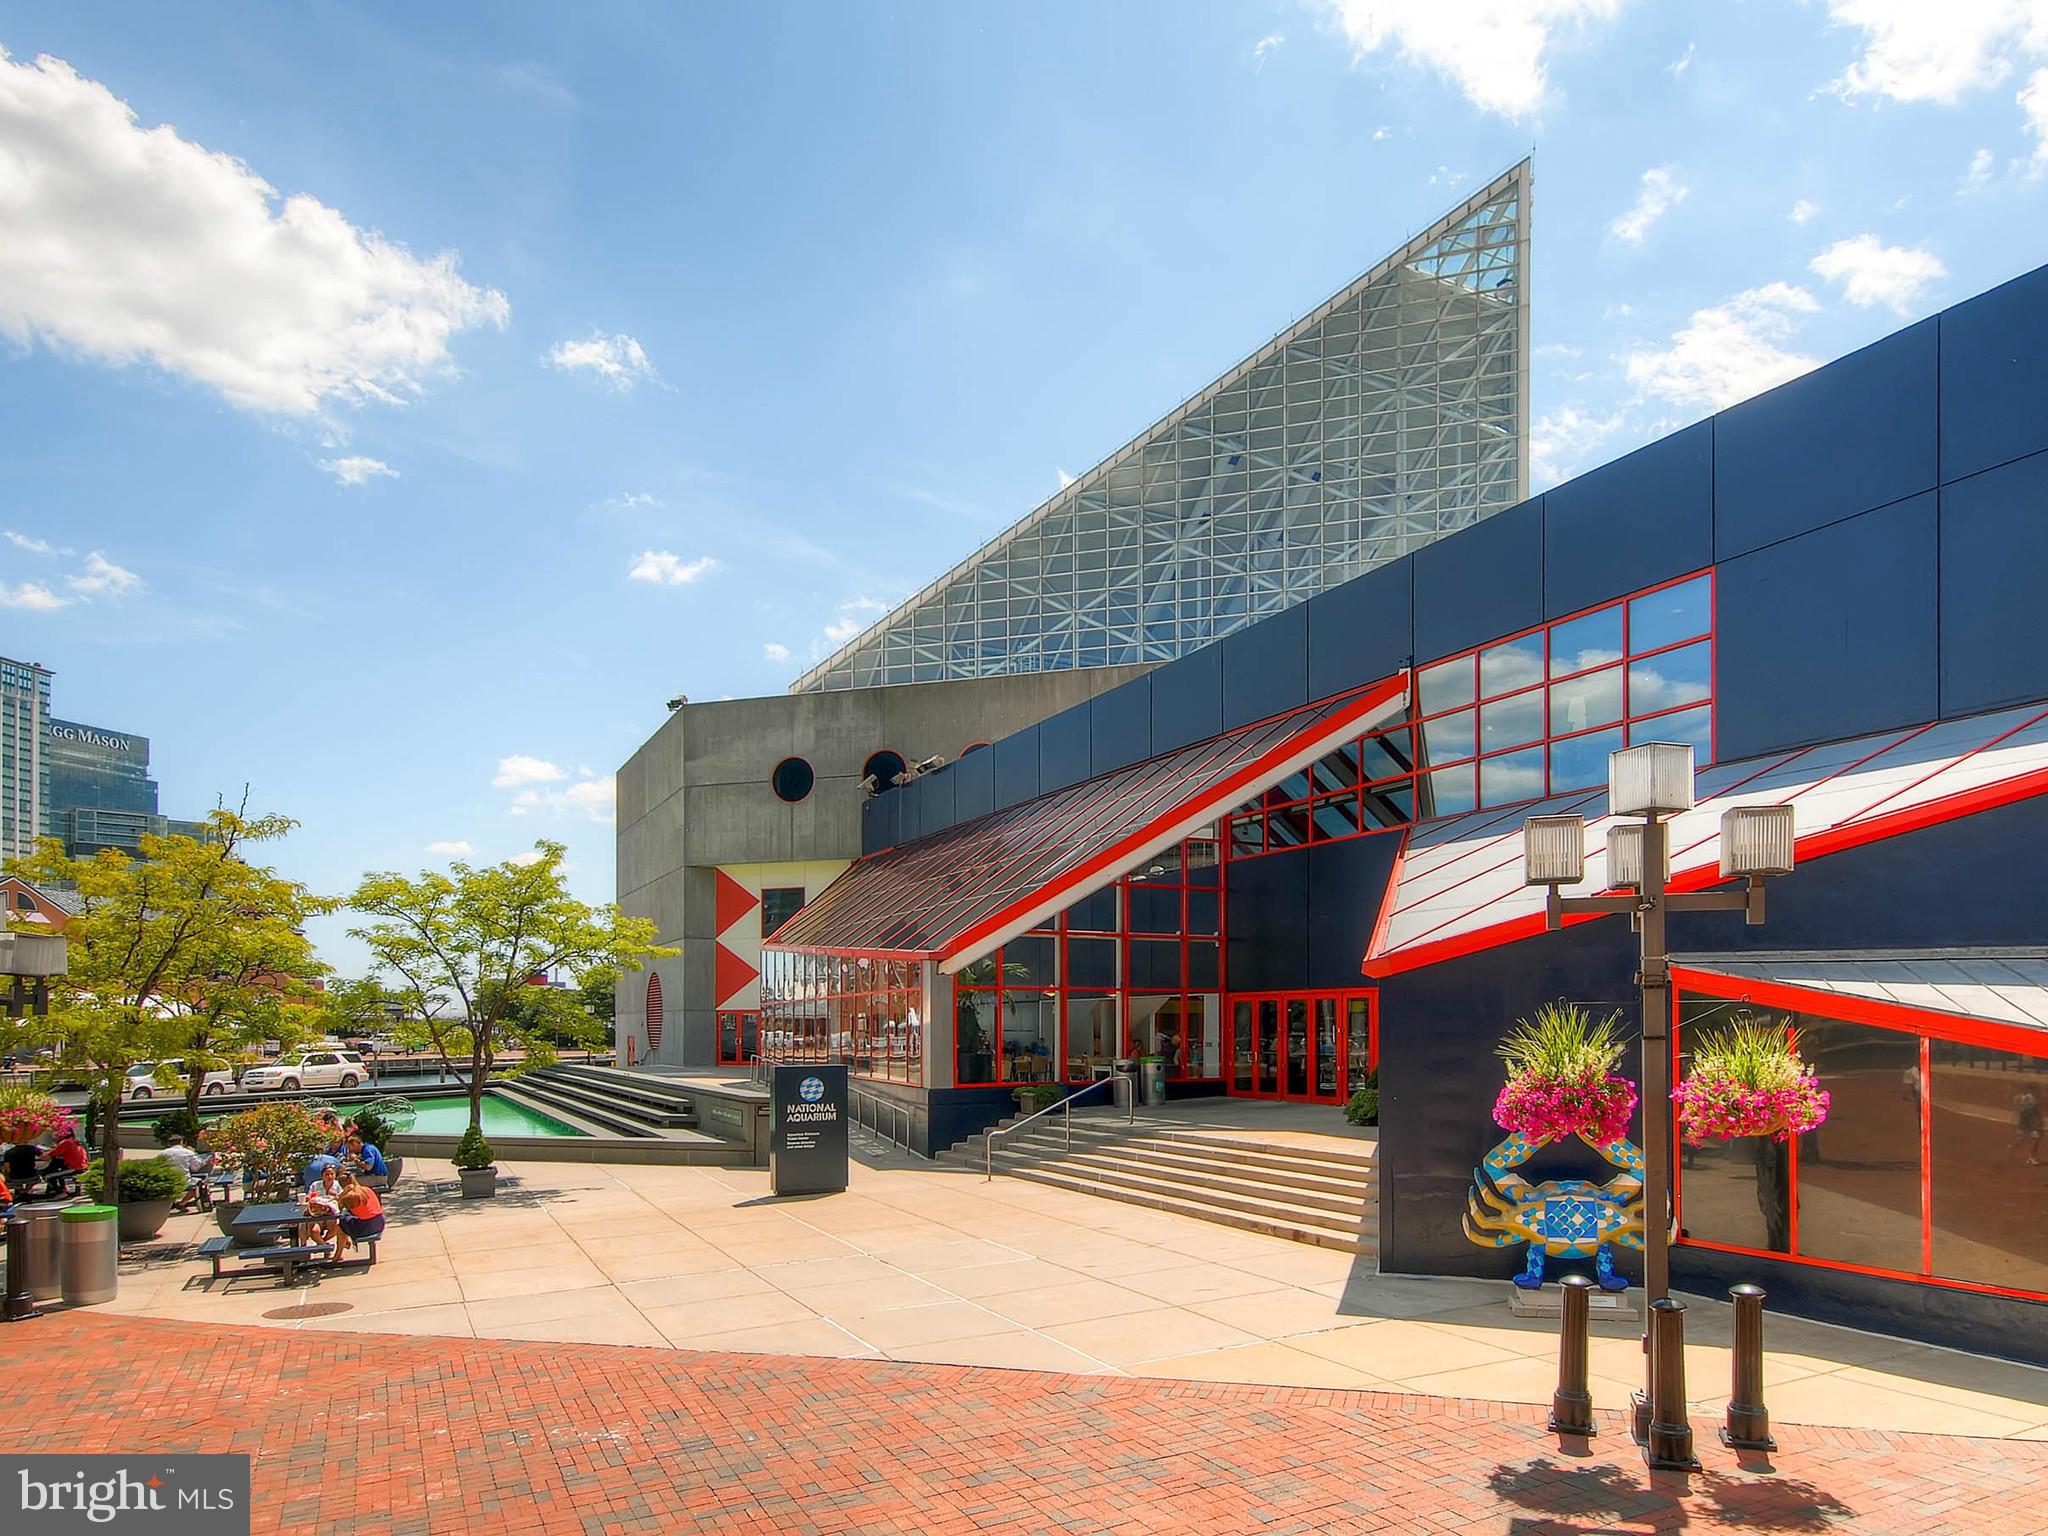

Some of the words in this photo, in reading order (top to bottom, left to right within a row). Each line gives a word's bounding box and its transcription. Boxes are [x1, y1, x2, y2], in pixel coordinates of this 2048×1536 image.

[78, 728, 130, 750] MASON
[787, 1103, 837, 1114] NATIONAL
[786, 1112, 837, 1122] AQUARIUM
